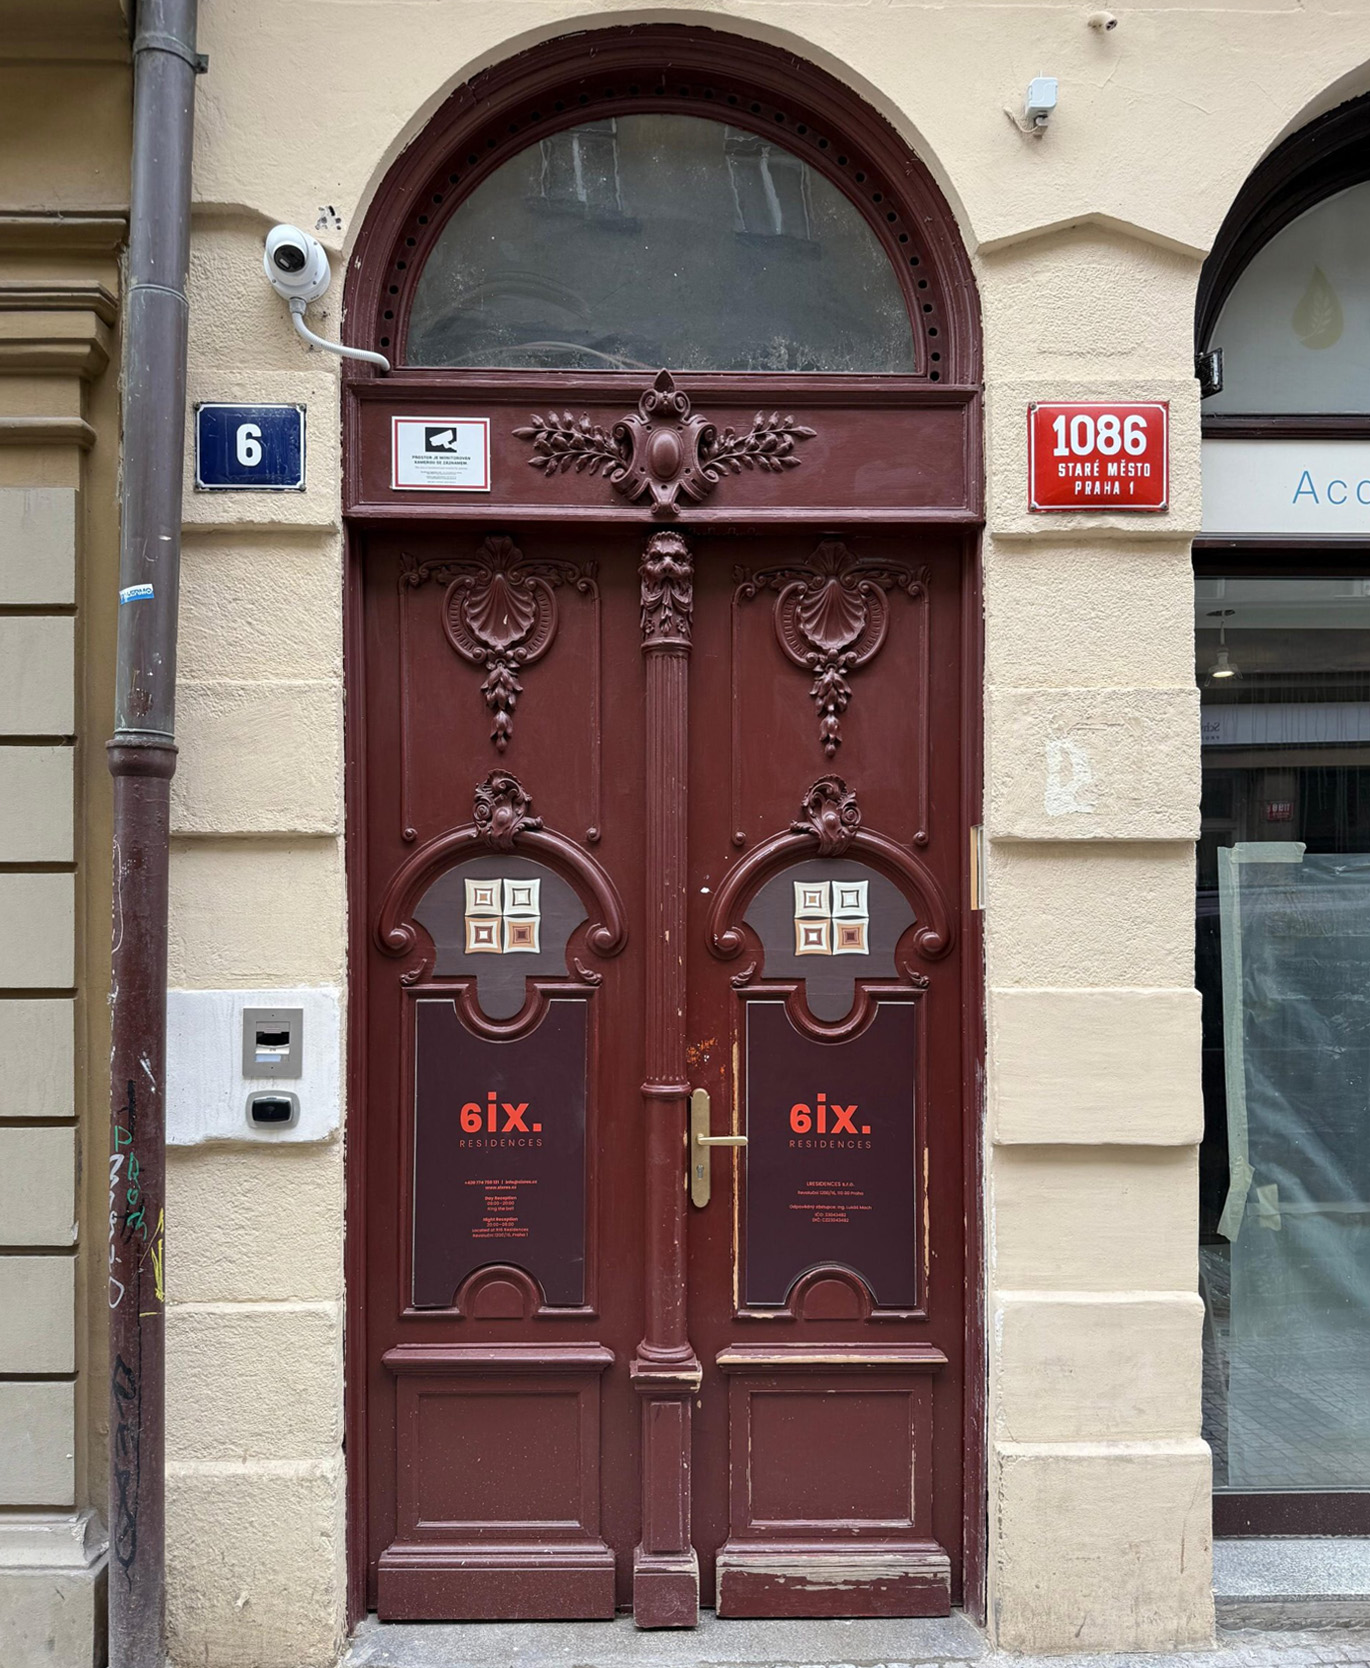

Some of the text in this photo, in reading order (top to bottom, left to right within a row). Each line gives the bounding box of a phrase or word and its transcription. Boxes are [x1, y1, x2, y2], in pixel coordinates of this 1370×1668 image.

[236, 423, 262, 467] 6
[1052, 414, 1148, 456] 1086
[1058, 459, 1151, 477] STARÉ MĚSTO
[1074, 481, 1134, 495] PRAHA 1
[460, 1091, 542, 1133] 6ix.
[790, 1093, 871, 1134] 6ix.
[459, 1139, 542, 1147] RESIDENCES
[789, 1140, 871, 1149] RESIDENCES
